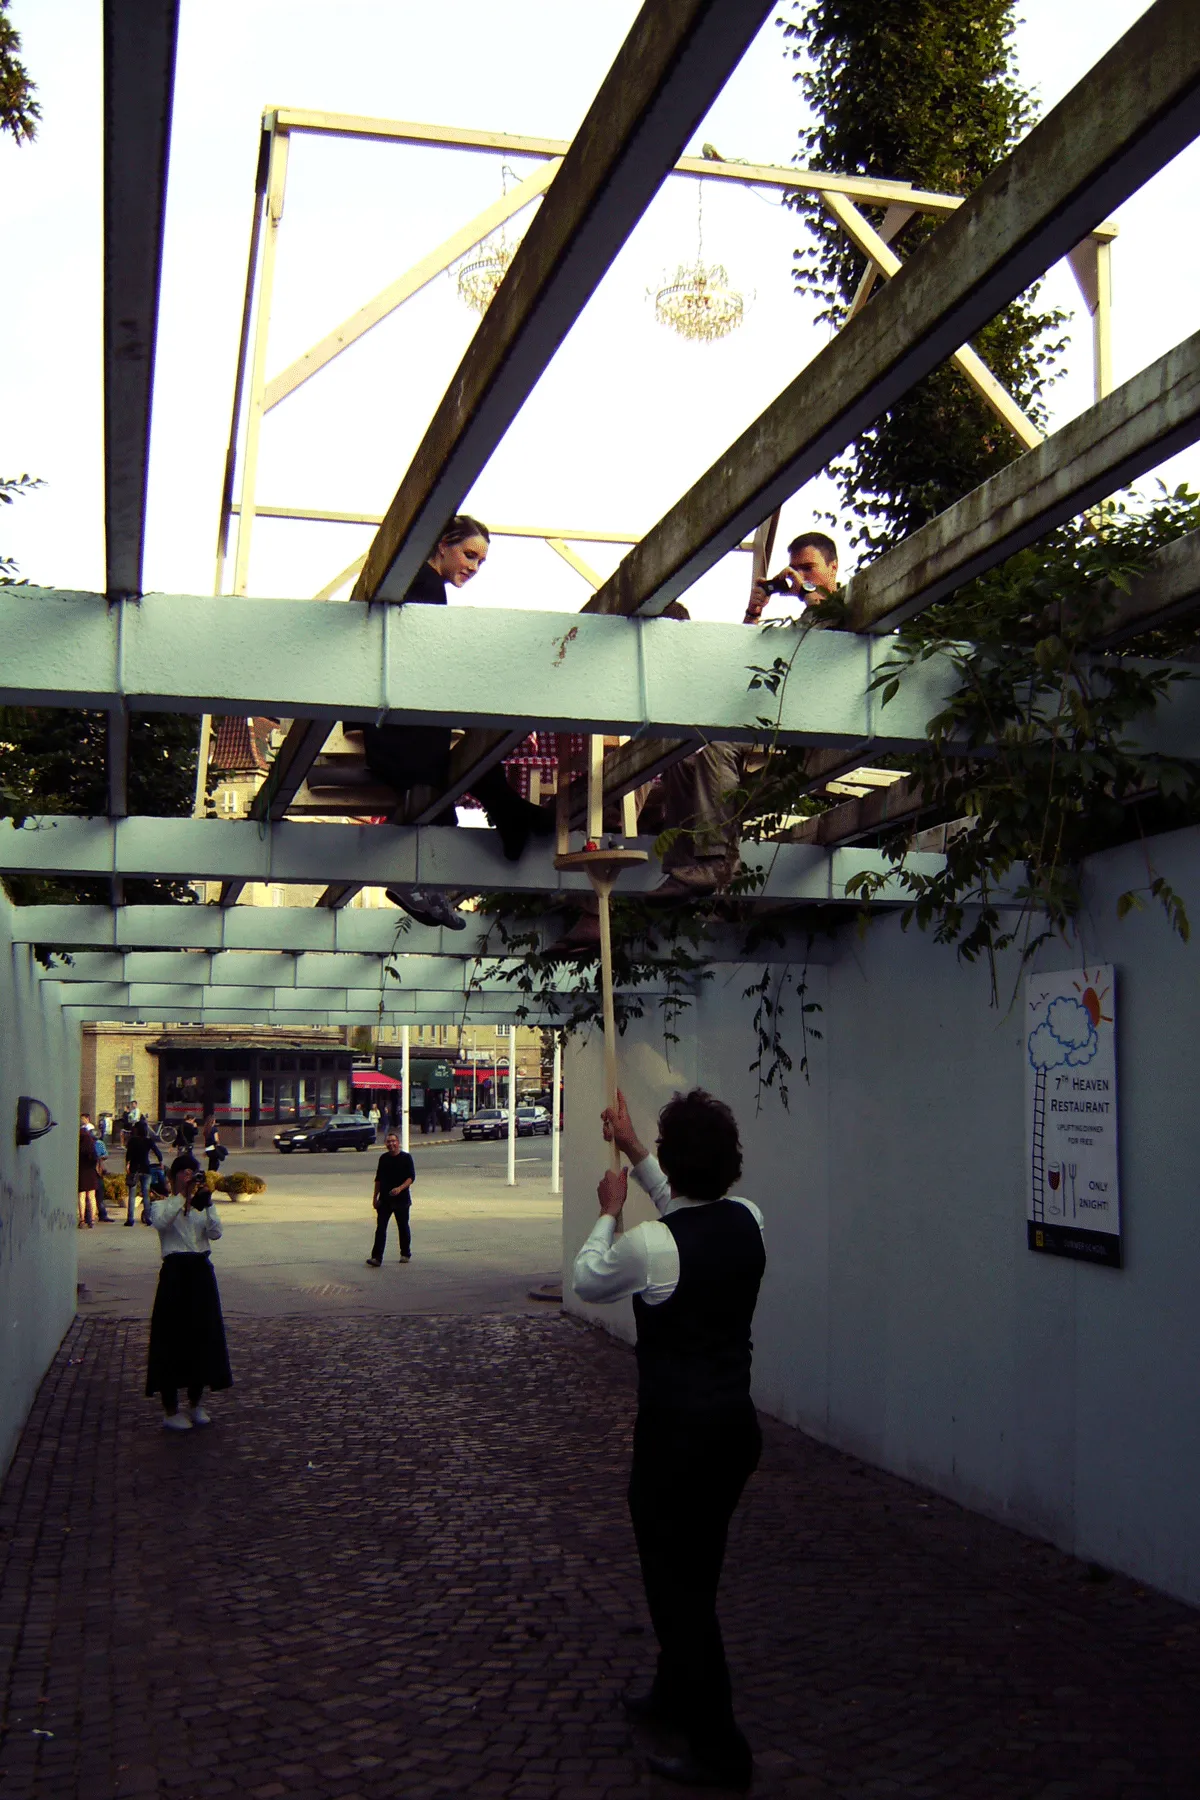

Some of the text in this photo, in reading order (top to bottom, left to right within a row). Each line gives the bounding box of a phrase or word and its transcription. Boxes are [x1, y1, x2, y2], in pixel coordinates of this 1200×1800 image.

[1072, 1077, 1109, 1091] HEAVEN
[1051, 1099, 1110, 1113] RESTAURANT
[1089, 1181, 1109, 1192] ONLY
